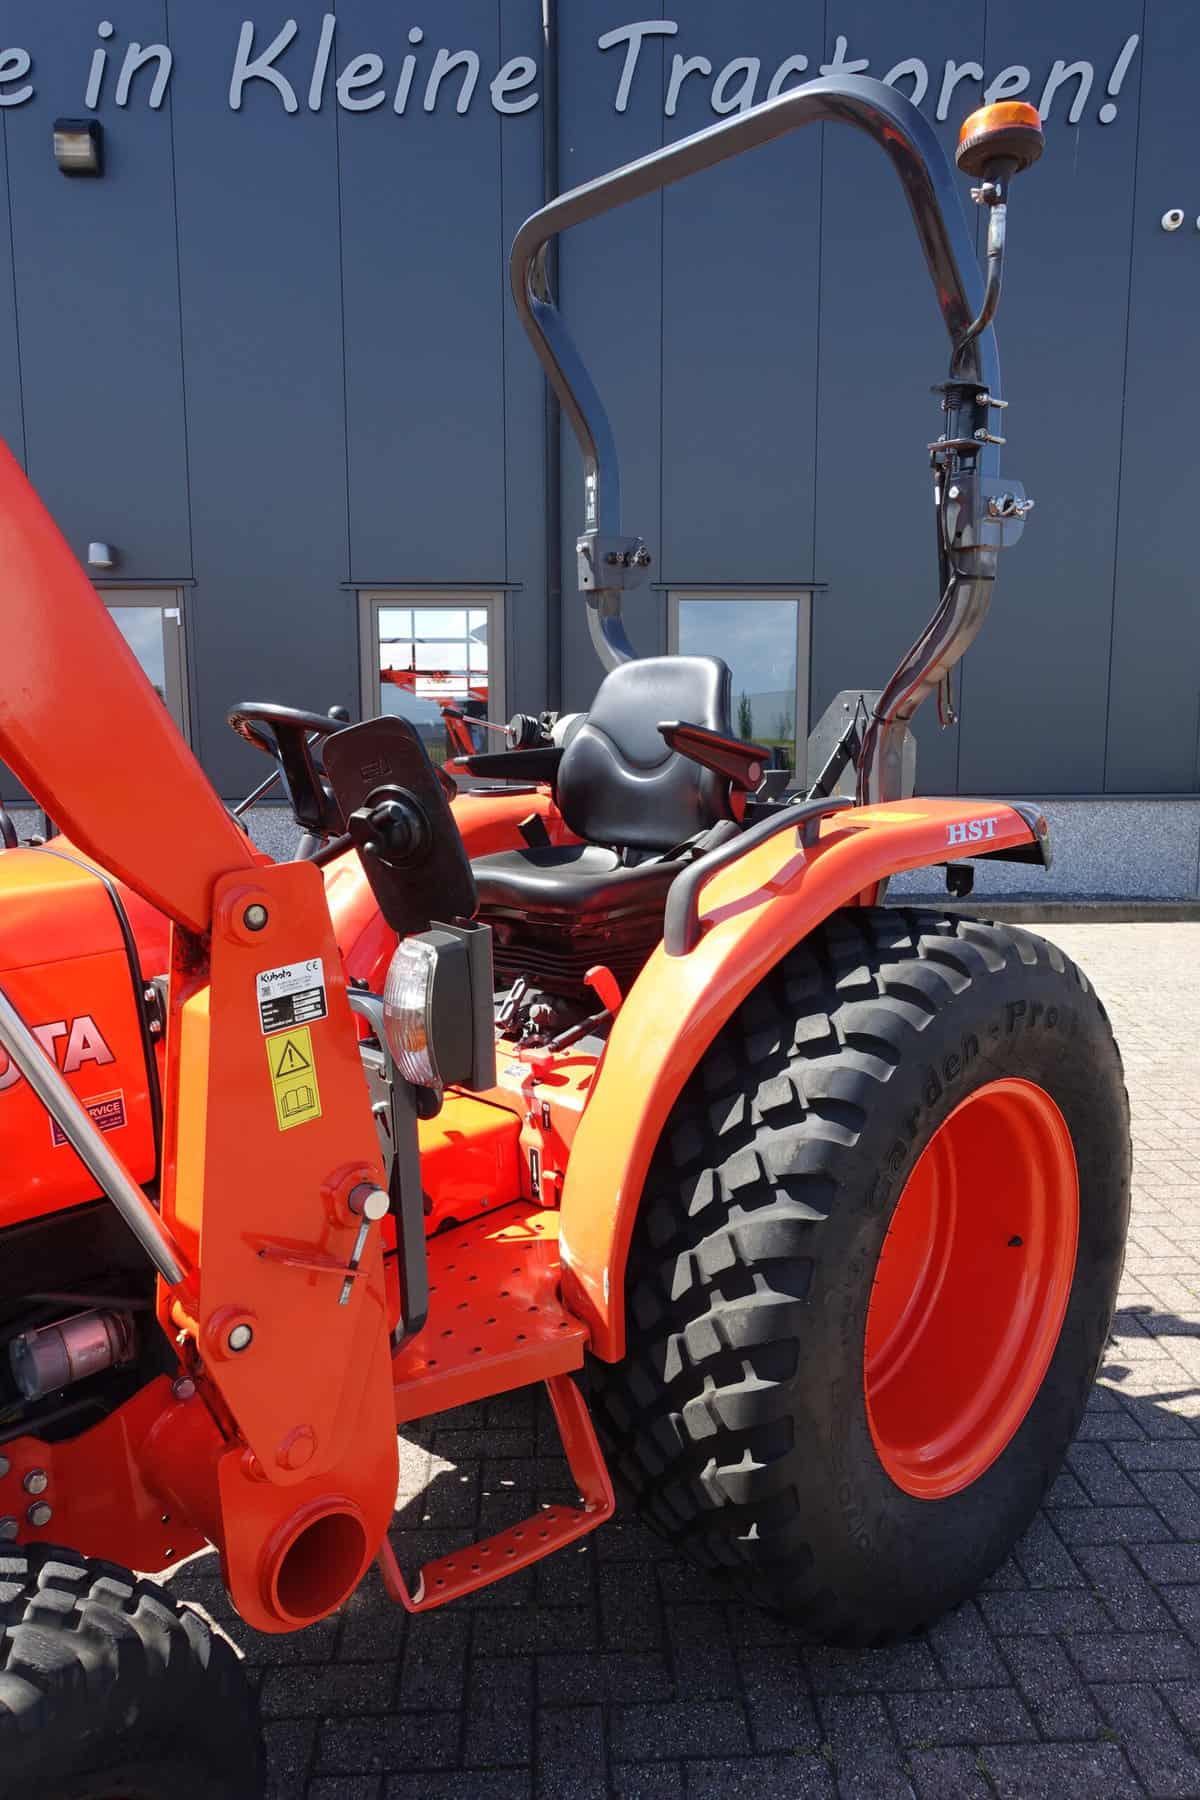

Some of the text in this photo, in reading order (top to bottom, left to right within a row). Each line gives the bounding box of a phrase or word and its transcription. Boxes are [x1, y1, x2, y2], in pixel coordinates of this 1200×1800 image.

[85, 20, 173, 109] in
[229, 13, 539, 115] Kleine
[946, 817, 998, 846] HST
[260, 969, 293, 983] Kubota
